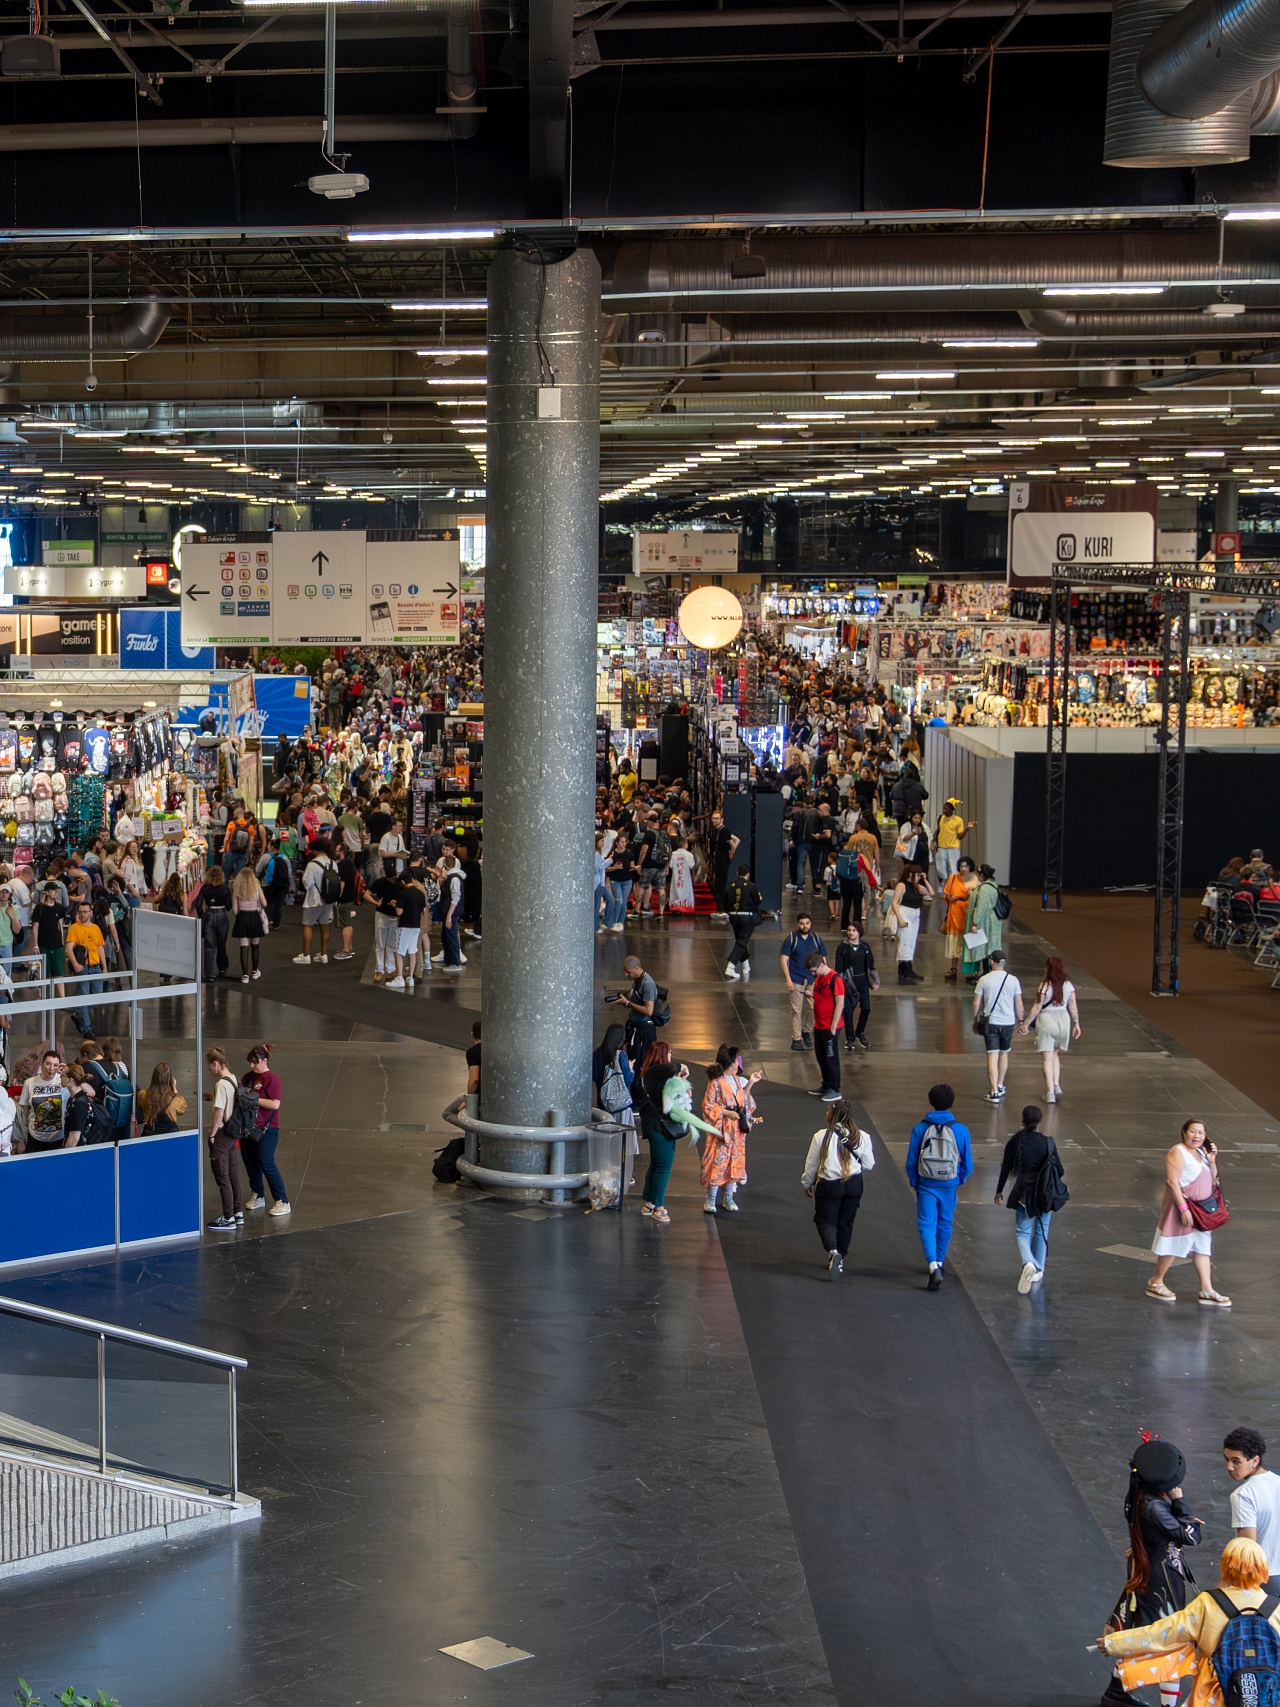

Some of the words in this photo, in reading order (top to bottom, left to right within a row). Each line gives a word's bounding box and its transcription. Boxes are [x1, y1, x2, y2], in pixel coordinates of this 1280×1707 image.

[1084, 537, 1113, 557] KURI
[67, 552, 80, 561] TAKÉ
[126, 633, 159, 651] Funko
